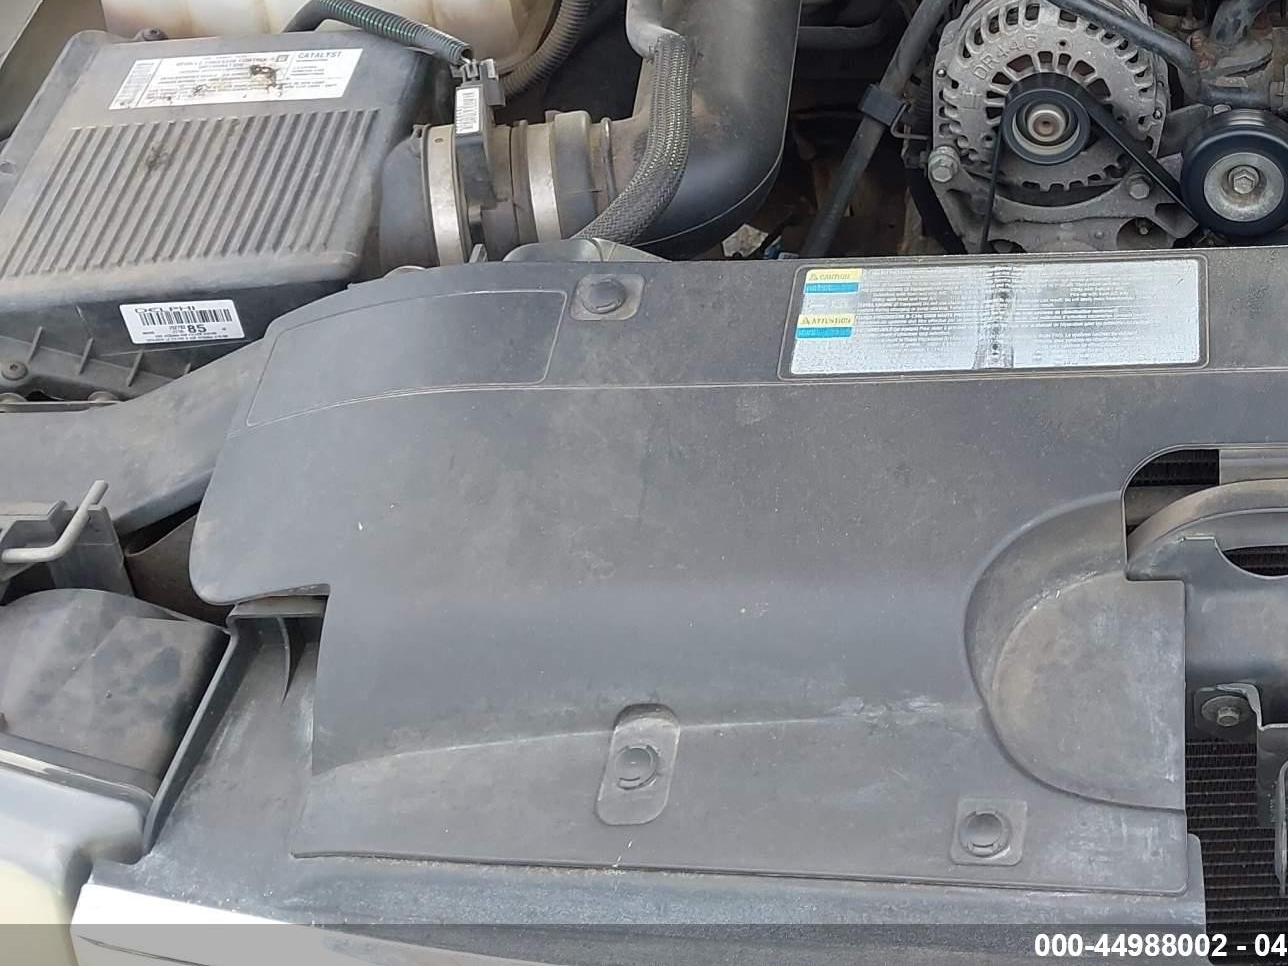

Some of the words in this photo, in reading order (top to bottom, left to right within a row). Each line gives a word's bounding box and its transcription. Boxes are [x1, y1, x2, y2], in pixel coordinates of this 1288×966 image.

[298, 51, 342, 59] CATALYST
[819, 273, 850, 281] CAUTION
[134, 305, 196, 314] DELPHI
[811, 316, 852, 325] ATTENTION
[187, 324, 207, 333] 85
